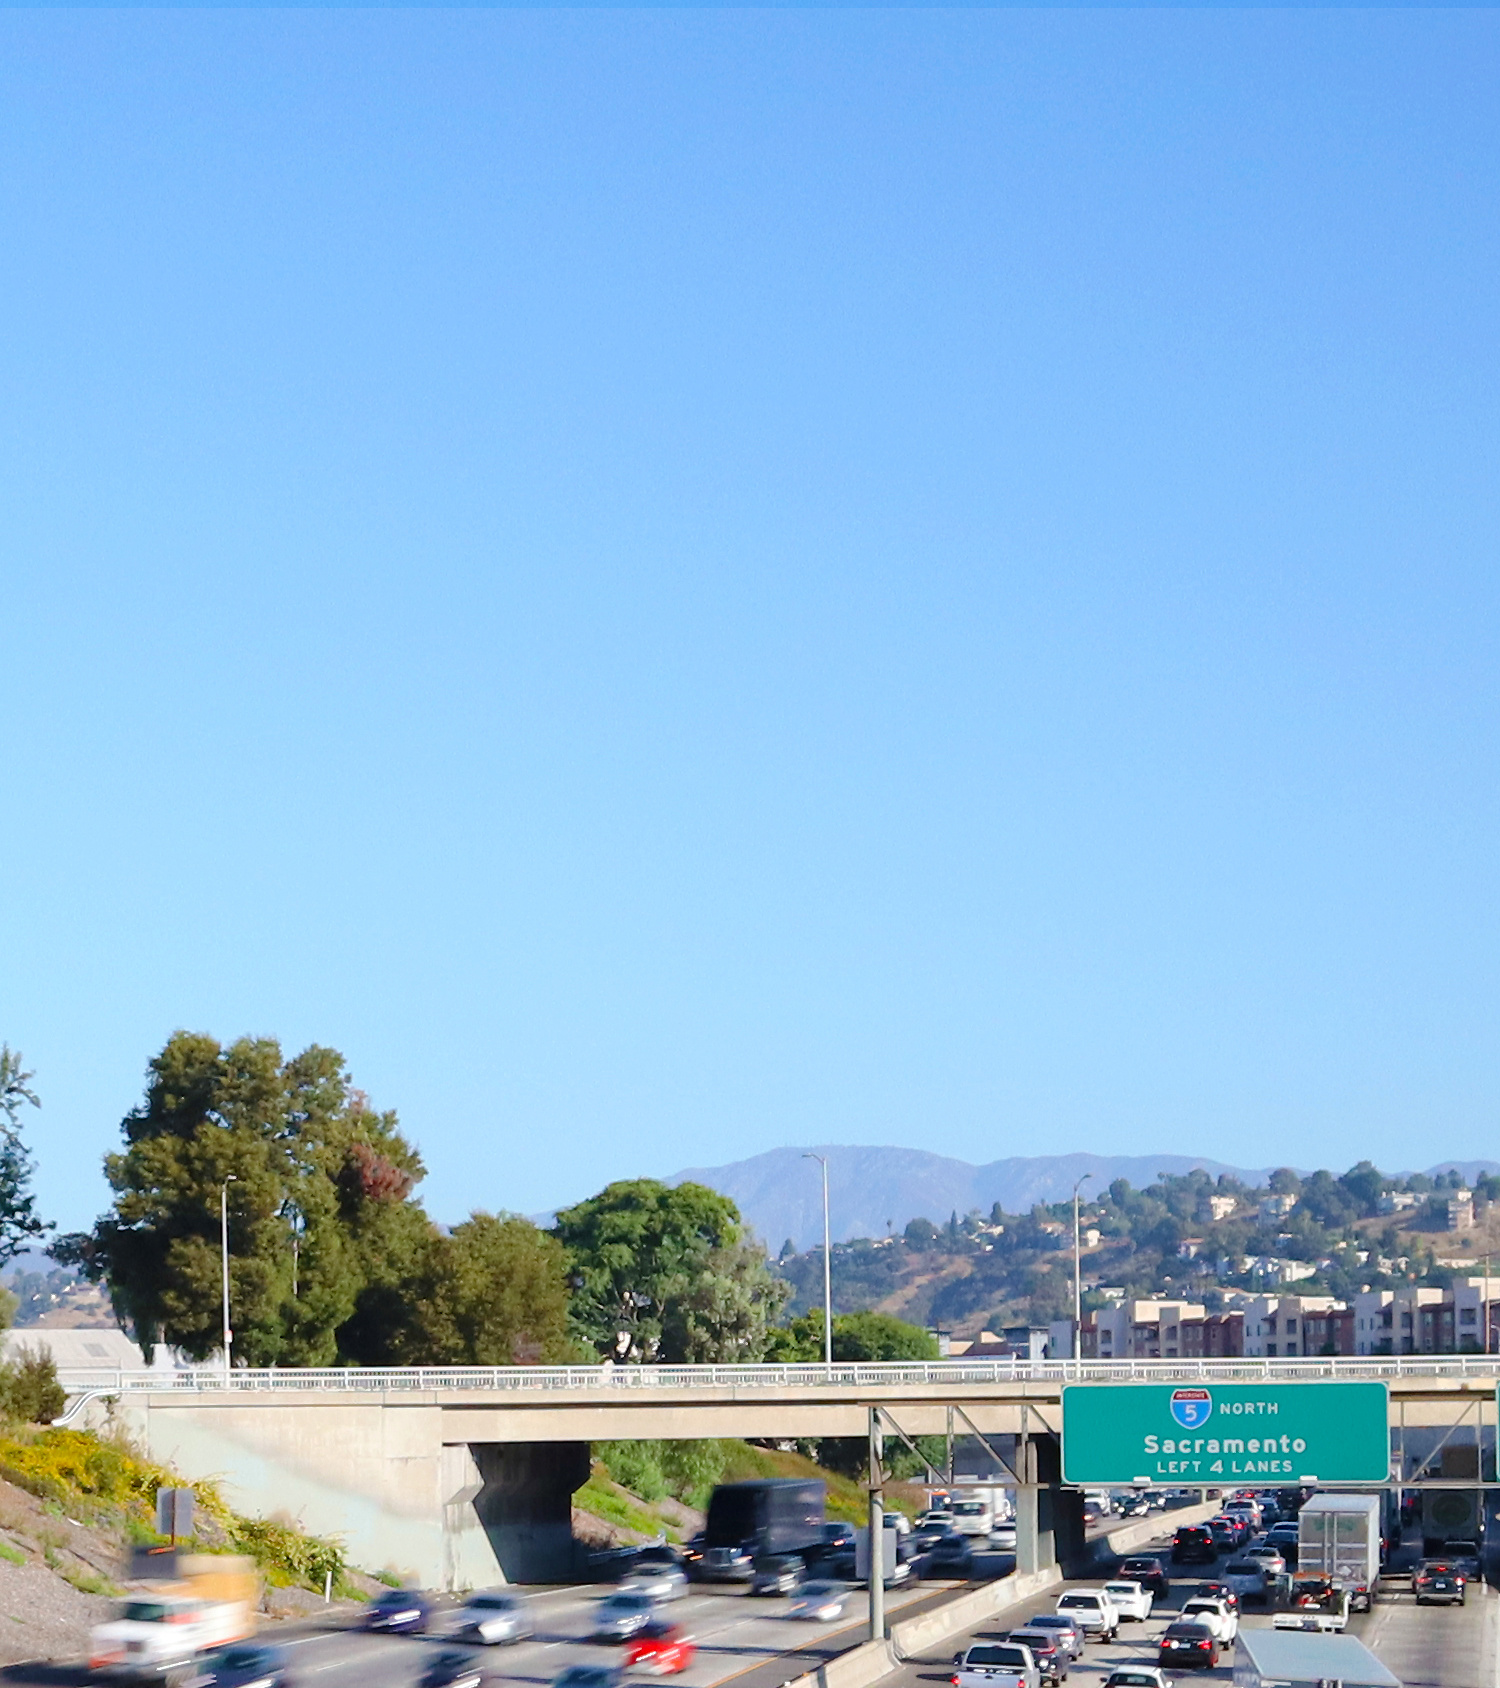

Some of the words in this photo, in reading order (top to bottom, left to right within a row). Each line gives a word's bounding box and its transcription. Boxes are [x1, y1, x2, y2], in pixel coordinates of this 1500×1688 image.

[1185, 1404, 1198, 1422] 5
[1220, 1402, 1279, 1415] NORTH
[1144, 1434, 1307, 1454] Sacramento
[1157, 1460, 1202, 1473] LEFT
[1209, 1459, 1224, 1474] 4
[1231, 1460, 1293, 1473] LANES
